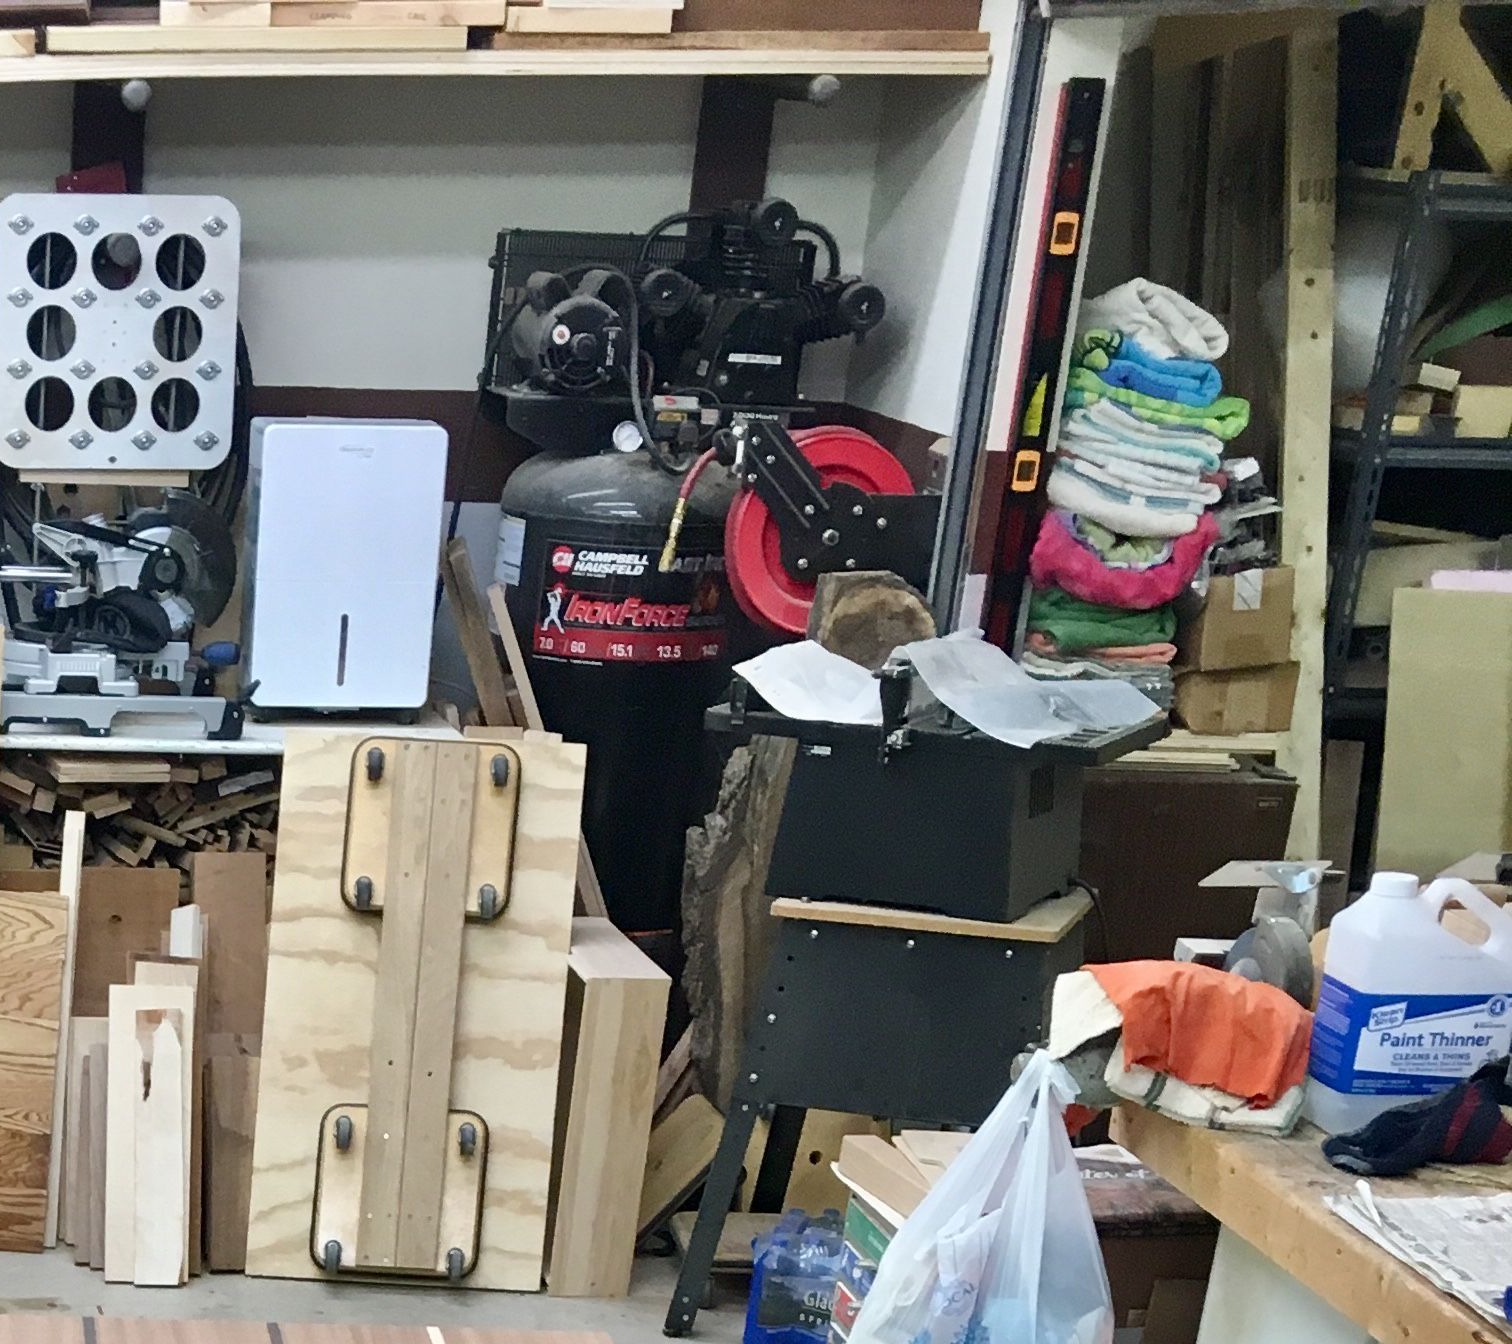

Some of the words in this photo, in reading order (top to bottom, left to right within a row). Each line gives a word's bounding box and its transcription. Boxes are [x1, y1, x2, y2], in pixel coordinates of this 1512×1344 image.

[578, 550, 649, 566] CAMPBELL
[573, 561, 645, 576] HAUSFELD
[610, 643, 633, 657] 15.1
[656, 645, 682, 659] 13.5
[1379, 1031, 1424, 1048] Paint
[1429, 1031, 1494, 1048] Thinner
[1392, 1052, 1430, 1061] CLEANS
[1442, 1052, 1471, 1061] THINS
